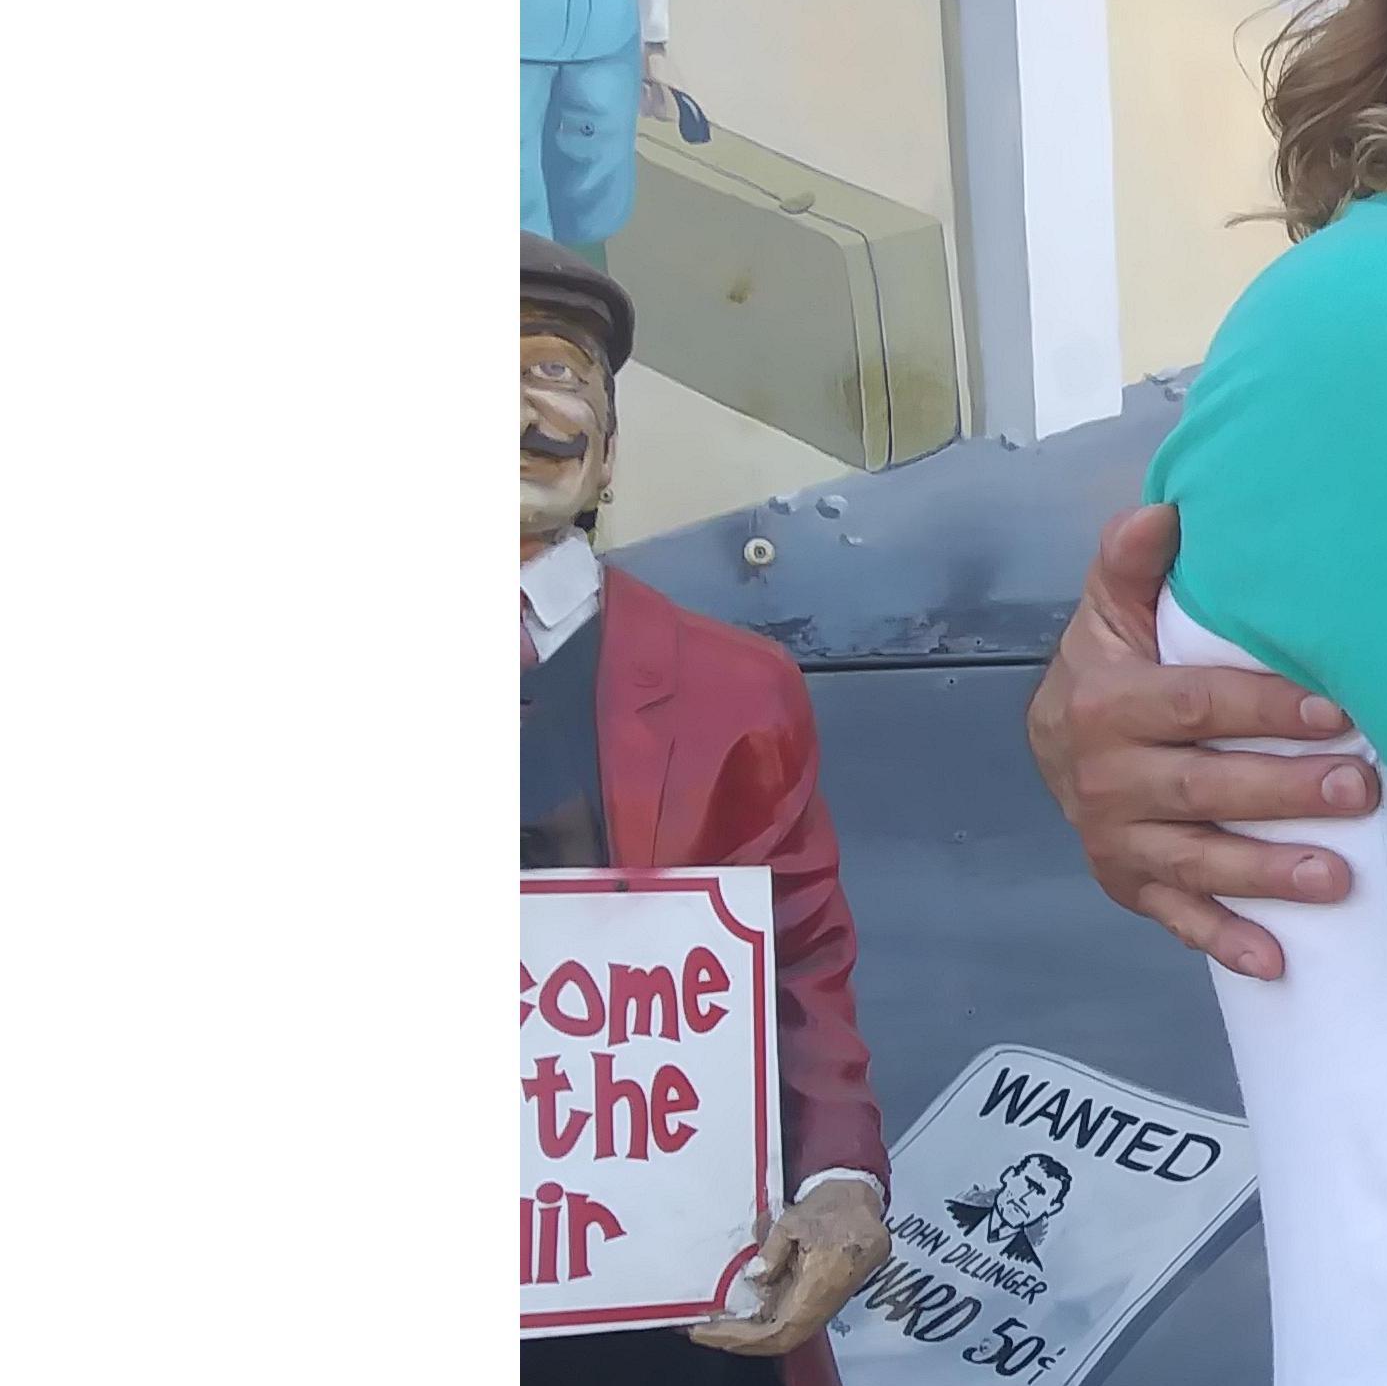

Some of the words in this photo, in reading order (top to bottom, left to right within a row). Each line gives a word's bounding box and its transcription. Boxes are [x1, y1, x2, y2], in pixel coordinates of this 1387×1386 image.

[521, 1051, 700, 1160] the
[979, 1067, 1221, 1182] WANTED
[886, 1213, 950, 1257] JOHN
[941, 1243, 1047, 1305] DILLINGER
